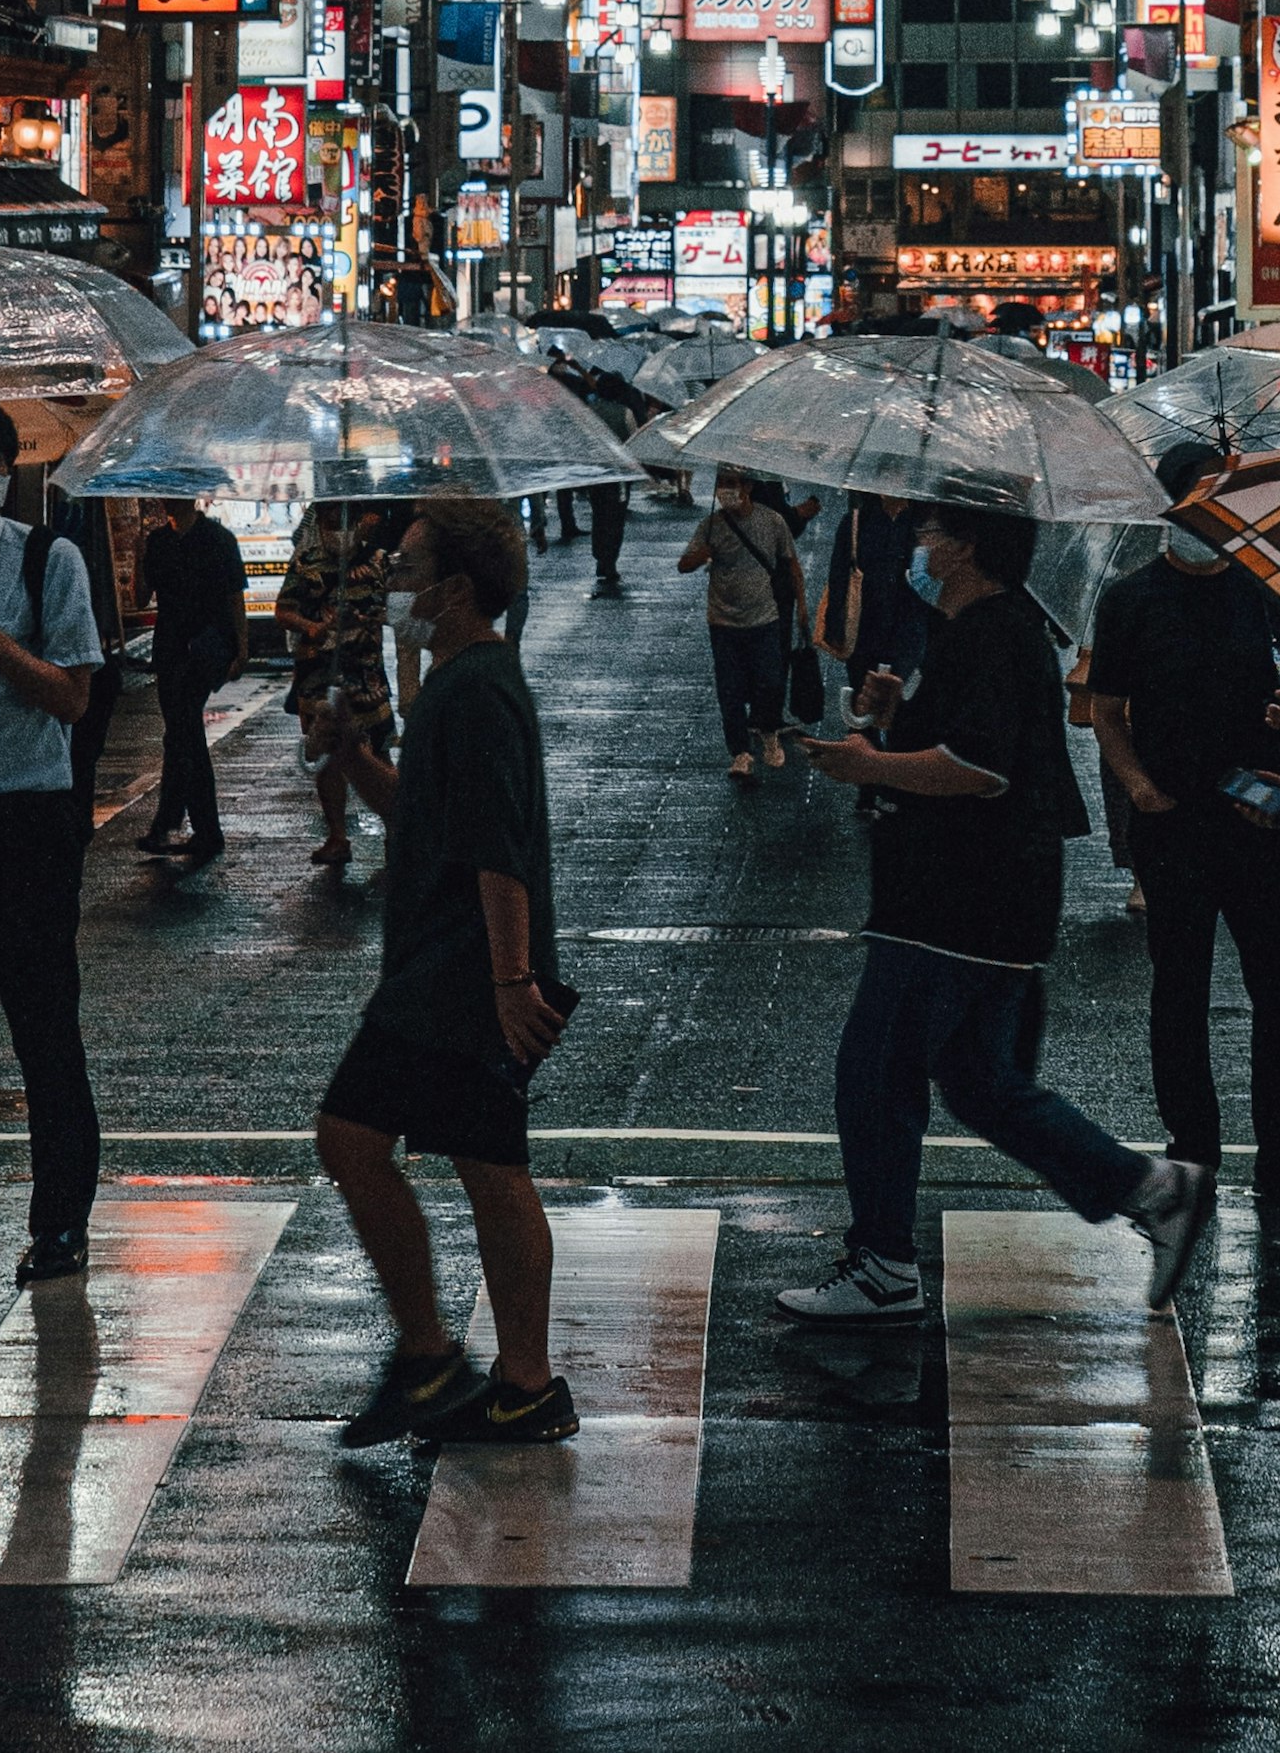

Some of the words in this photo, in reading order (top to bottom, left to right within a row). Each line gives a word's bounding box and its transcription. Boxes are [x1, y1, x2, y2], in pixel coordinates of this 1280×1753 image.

[922, 141, 1002, 162] コーヒー
[682, 241, 744, 265] ゲーム
